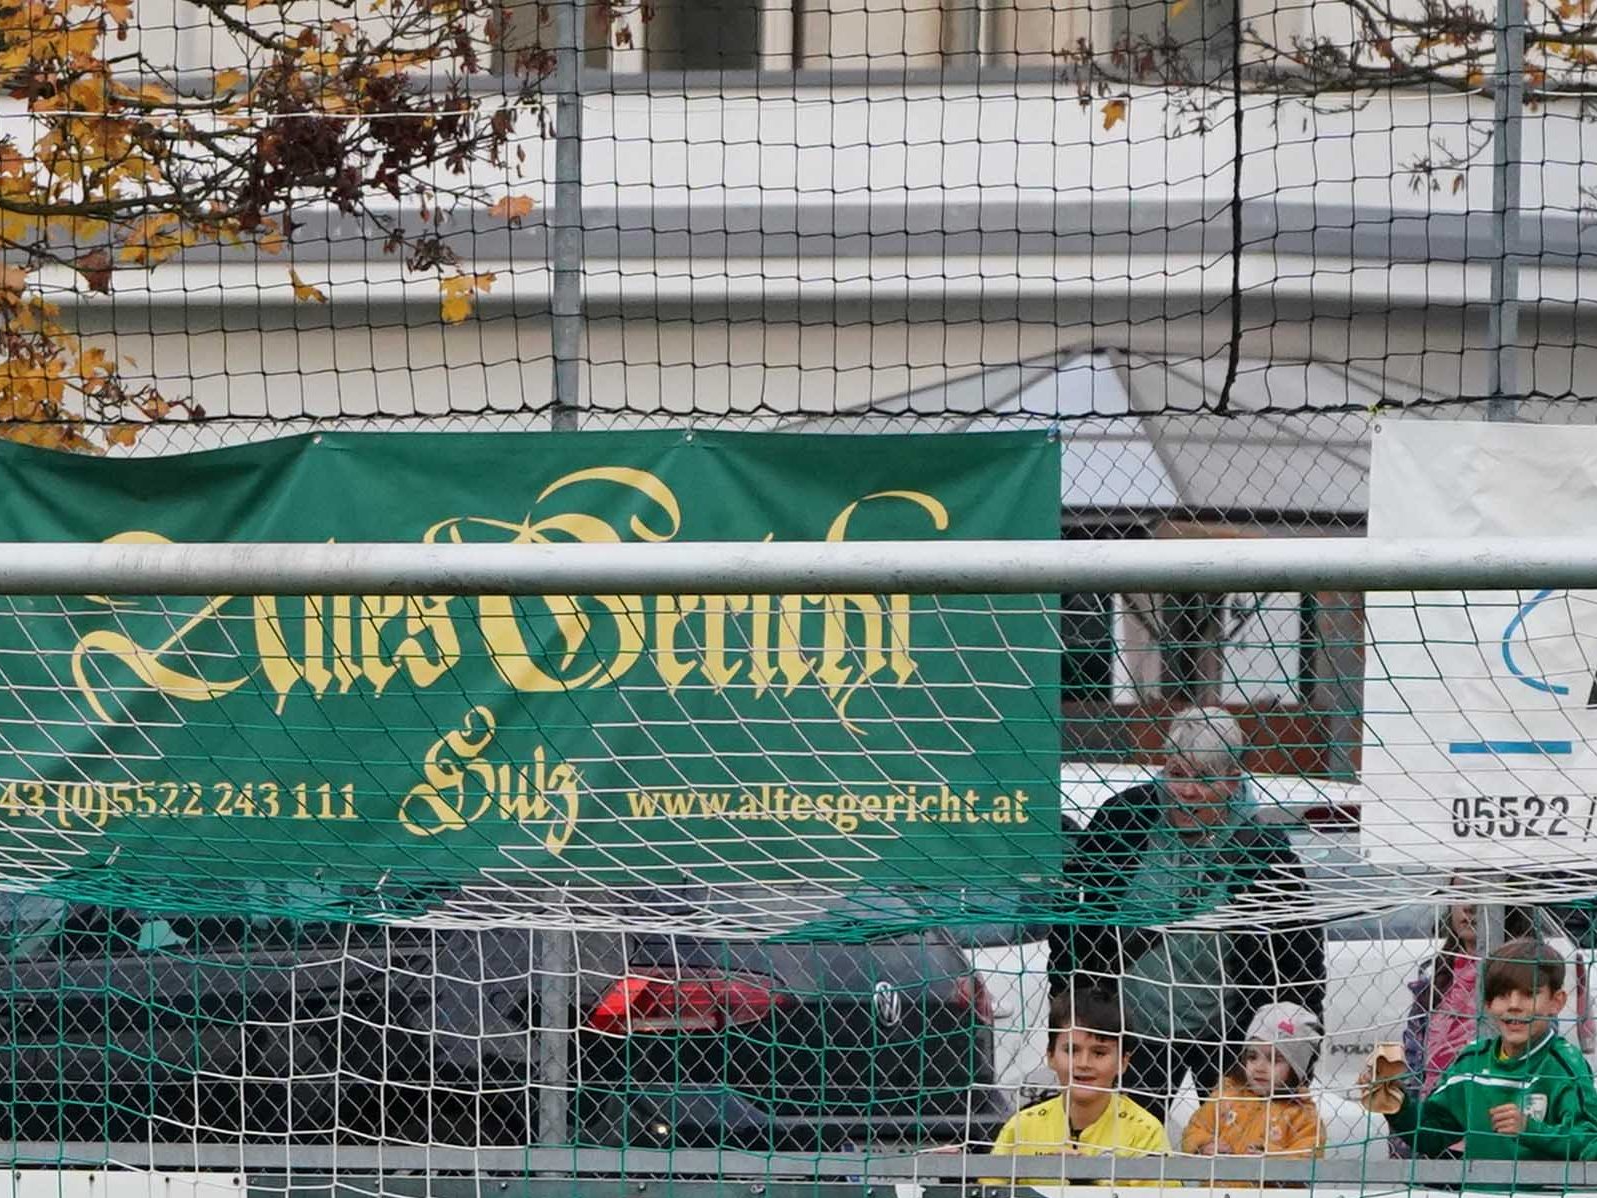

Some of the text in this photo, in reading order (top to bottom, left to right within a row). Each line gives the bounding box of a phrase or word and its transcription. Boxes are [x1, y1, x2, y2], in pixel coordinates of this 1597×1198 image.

[213, 782, 281, 818] 243
[292, 783, 359, 820] 111
[398, 705, 583, 856] Sulz
[626, 785, 1030, 833] www.altesgericht.at
[1452, 796, 1571, 838] 05522
